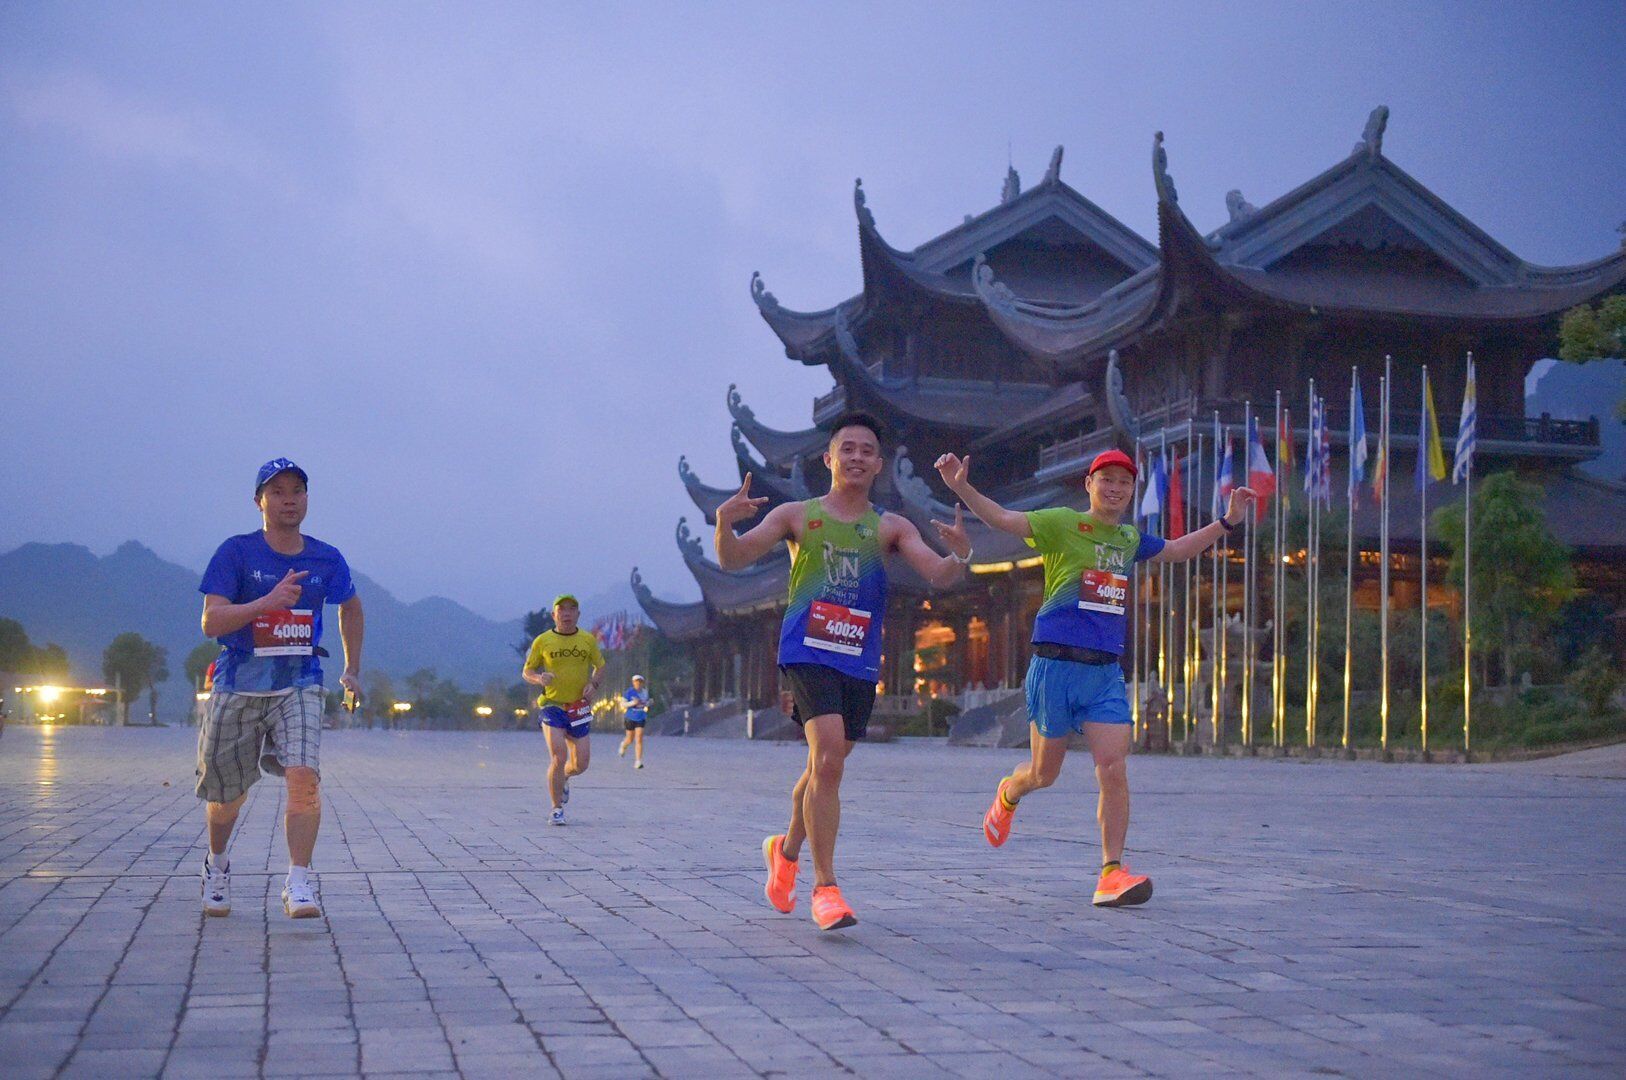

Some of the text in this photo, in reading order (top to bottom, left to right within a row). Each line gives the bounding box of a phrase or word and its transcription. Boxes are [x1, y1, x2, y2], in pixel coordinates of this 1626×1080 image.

[1097, 585, 1126, 600] 40023
[273, 624, 312, 639] 40080
[825, 620, 865, 640] 40024
